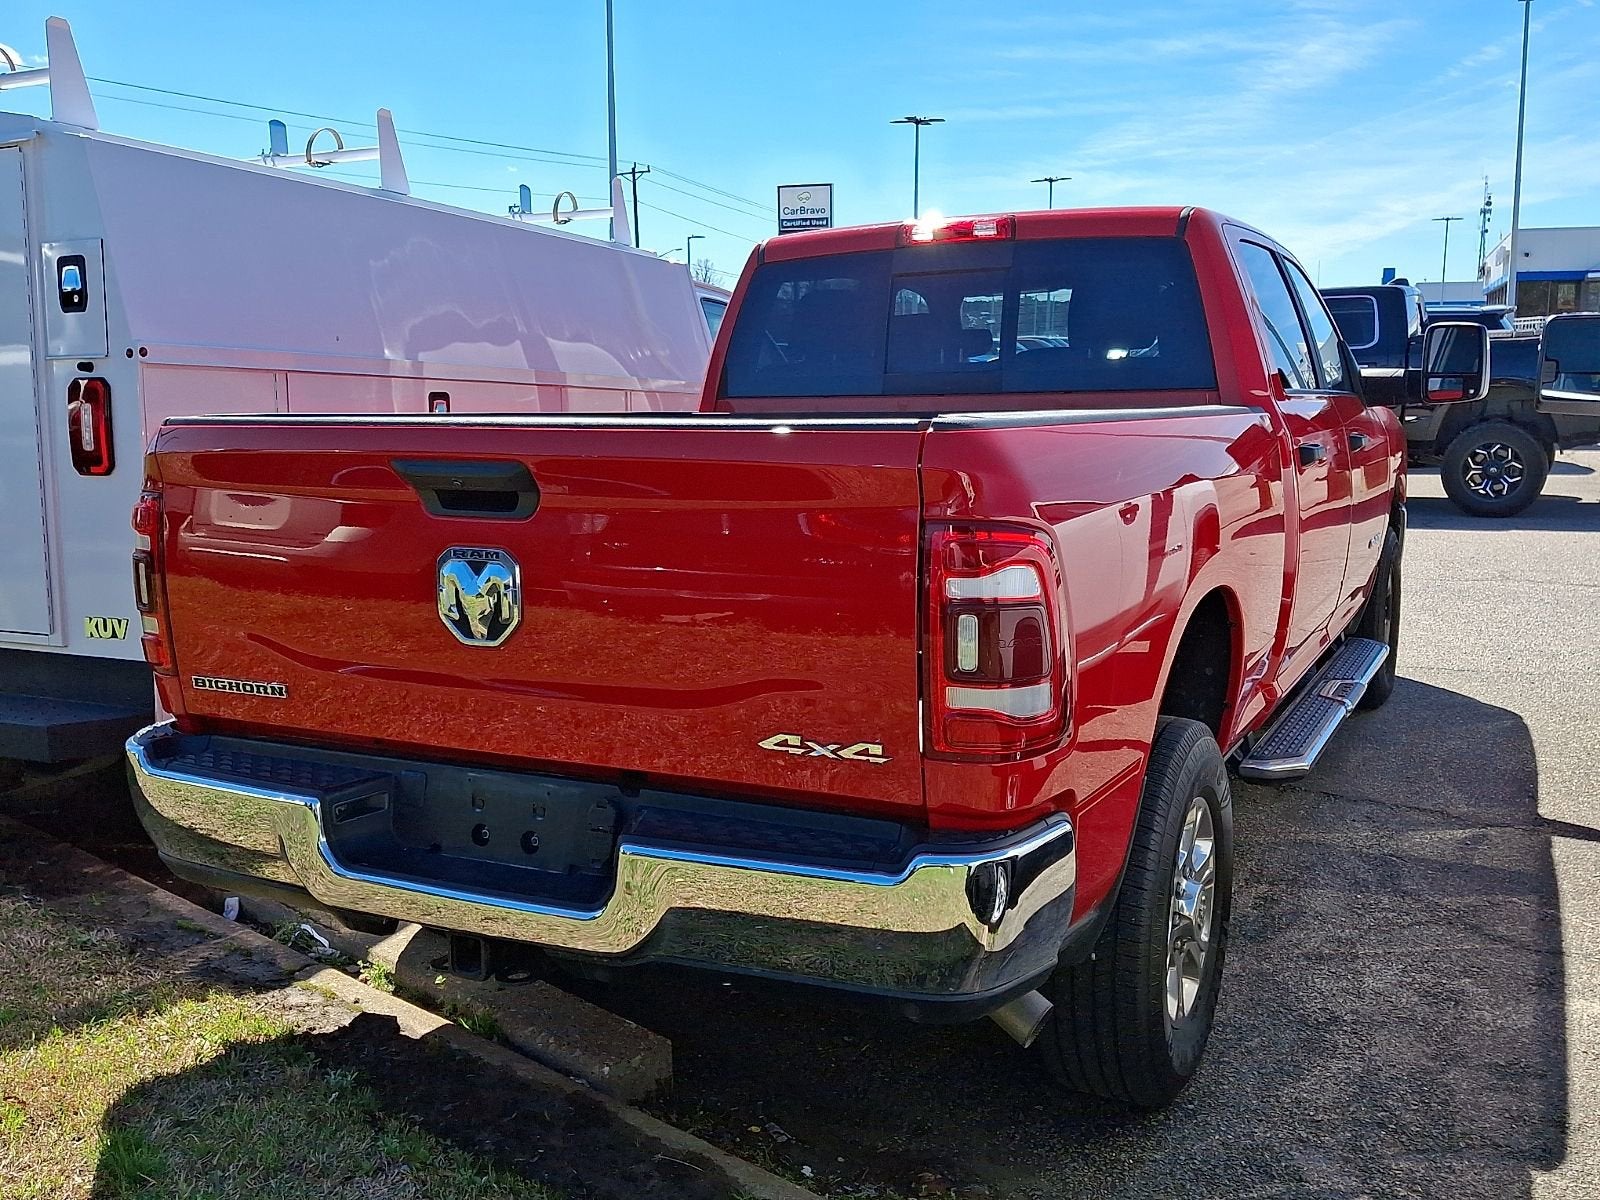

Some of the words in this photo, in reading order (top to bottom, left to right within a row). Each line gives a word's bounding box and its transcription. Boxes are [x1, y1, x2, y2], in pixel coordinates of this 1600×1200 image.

[783, 206, 826, 216] CarBravo
[450, 549, 500, 560] RAM
[84, 616, 129, 640] KUV
[191, 675, 287, 699] BIGHORN
